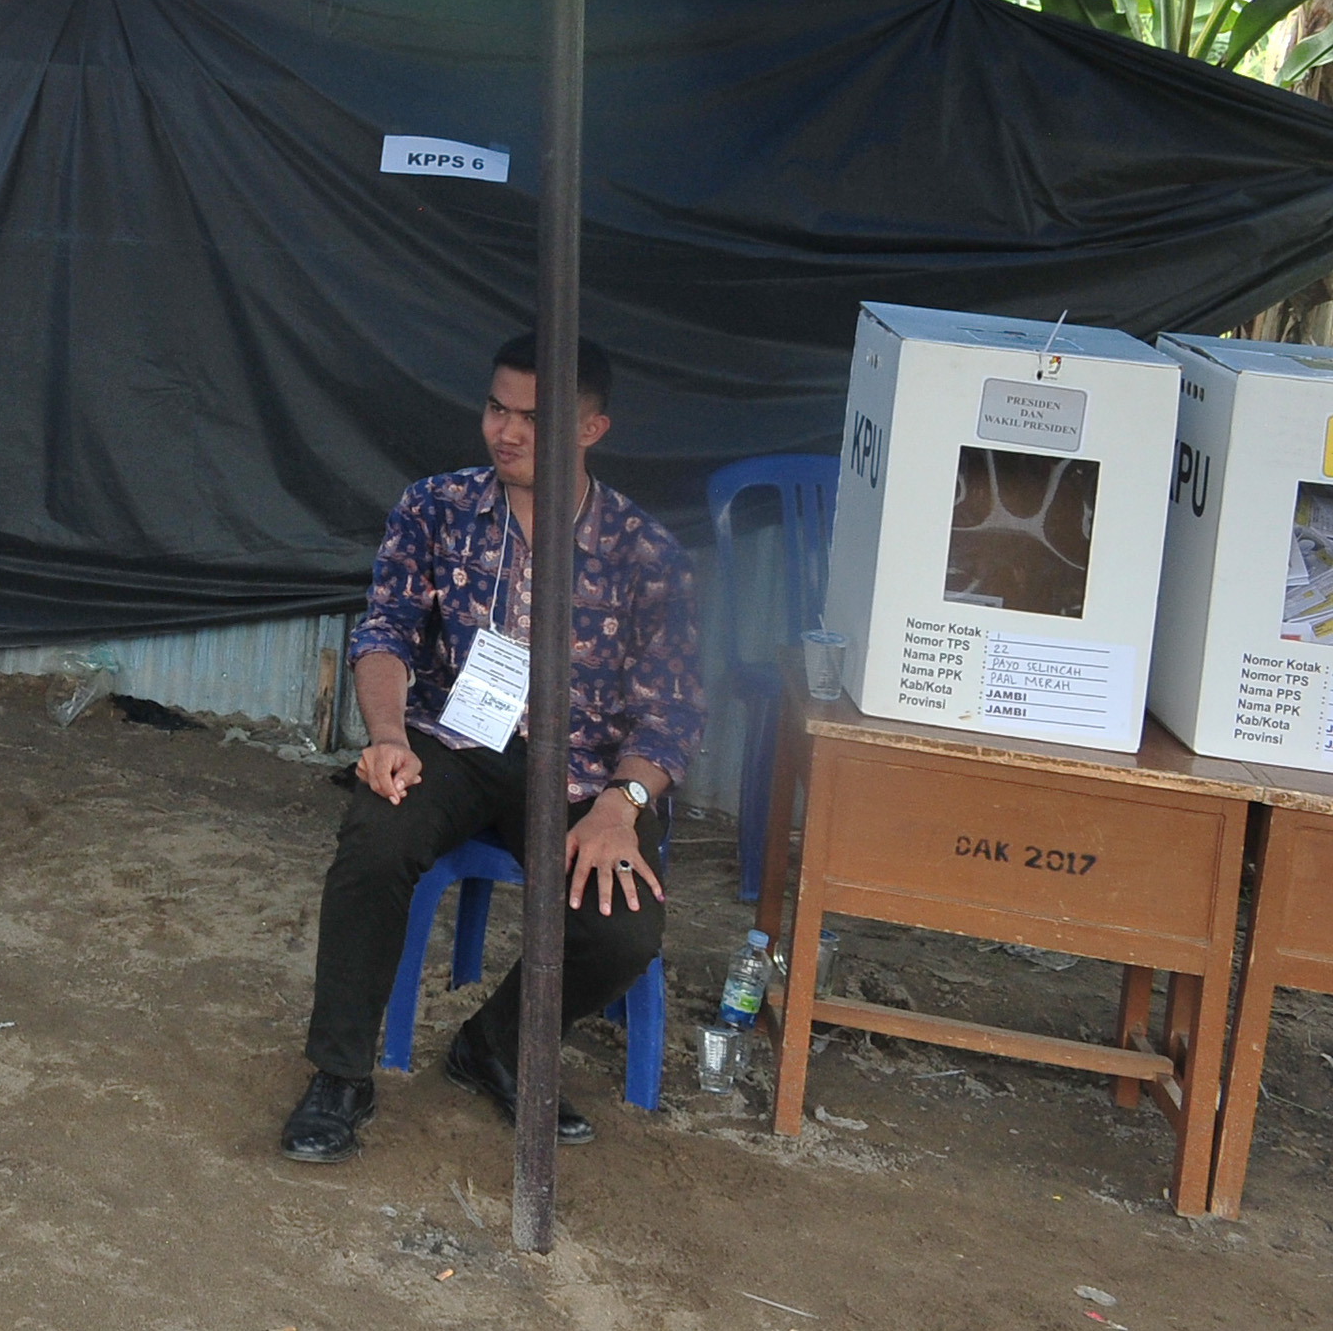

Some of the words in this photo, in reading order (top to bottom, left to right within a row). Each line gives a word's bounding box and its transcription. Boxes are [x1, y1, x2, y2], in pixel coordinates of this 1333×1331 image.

[407, 153, 465, 168] KPPS
[472, 158, 484, 170] 6
[1006, 395, 1061, 410] PRESIDEN
[984, 414, 1021, 427] WAKIL
[1023, 420, 1077, 435] PRESIDEN
[1020, 409, 1044, 419] DAN
[851, 410, 882, 489] KPU
[1170, 439, 1210, 517] PU
[906, 617, 945, 632] Nomor
[948, 623, 982, 638] Kotak
[904, 632, 944, 647] Nomor
[947, 638, 970, 651] TPS
[993, 644, 1009, 654] 22
[903, 648, 935, 662] Nama
[939, 653, 963, 666] PPS
[993, 658, 1019, 671] PAYO
[1242, 653, 1283, 668] Nomor
[1286, 659, 1321, 673] Kotak
[901, 663, 934, 677] Nama
[937, 668, 963, 681] PPK
[1024, 676, 1071, 691] MERAH
[1241, 668, 1282, 683] Nomor
[1285, 674, 1309, 687] TPS
[900, 678, 953, 695] Kab/Kota
[985, 689, 1027, 702] JAMBI
[1239, 683, 1273, 697] Nama
[1276, 688, 1302, 701] PPS
[898, 693, 946, 709] Provinsi
[985, 705, 1027, 717] JAMBI
[1237, 698, 1271, 712] Nama
[1274, 703, 1301, 717] PPK
[1236, 713, 1290, 730] Kab/Kota
[1234, 728, 1283, 745] Provinsi
[955, 836, 1009, 862] DAK
[1024, 846, 1096, 875] 2017
